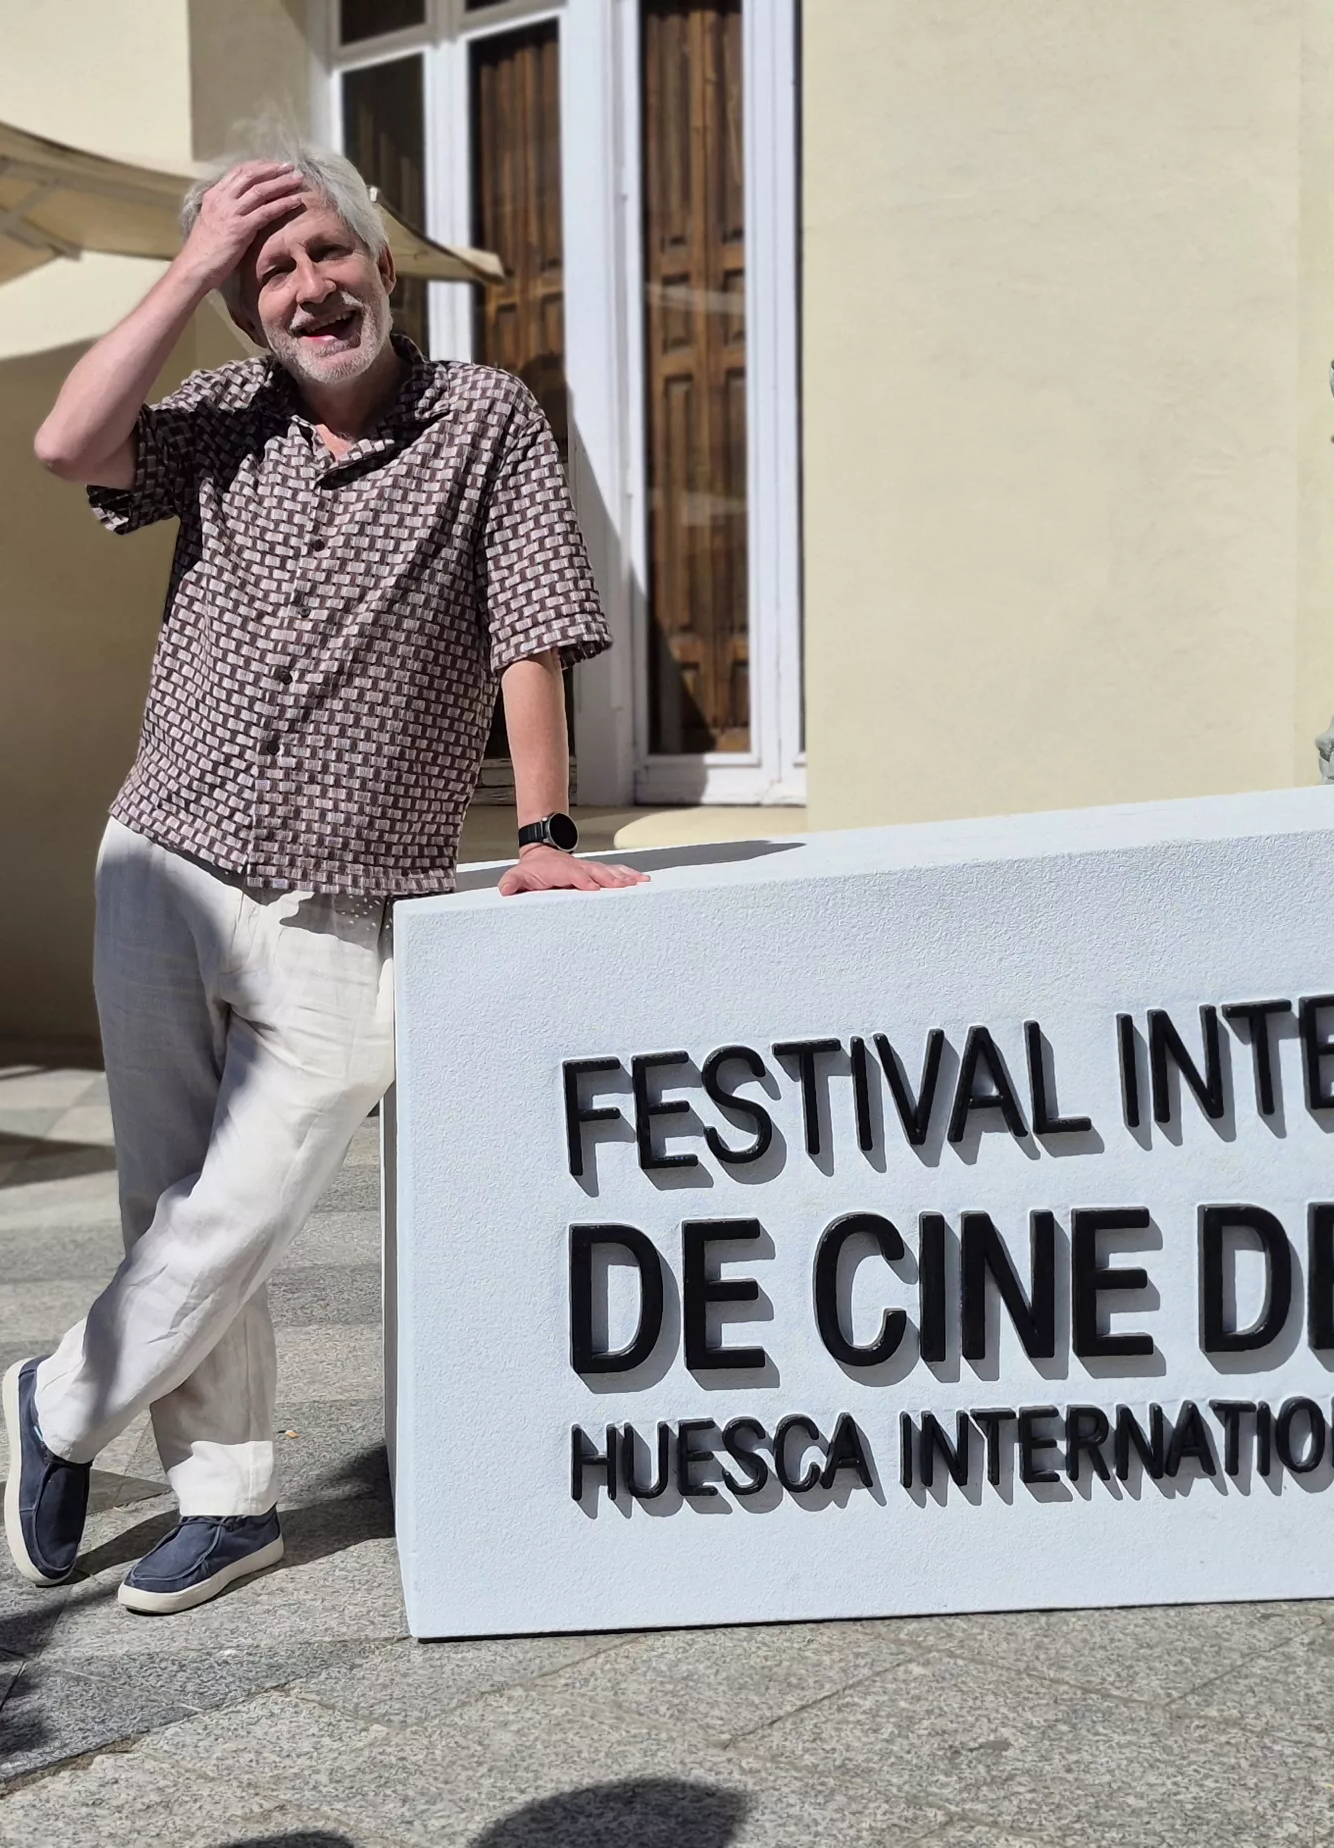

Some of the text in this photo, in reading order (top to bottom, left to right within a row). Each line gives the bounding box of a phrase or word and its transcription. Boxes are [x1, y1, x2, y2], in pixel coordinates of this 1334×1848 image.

[563, 1021, 1092, 1176] FESTIVAL
[569, 1219, 766, 1374] DE
[813, 1210, 1155, 1367] CINE
[571, 1413, 873, 1501] HUESCA
